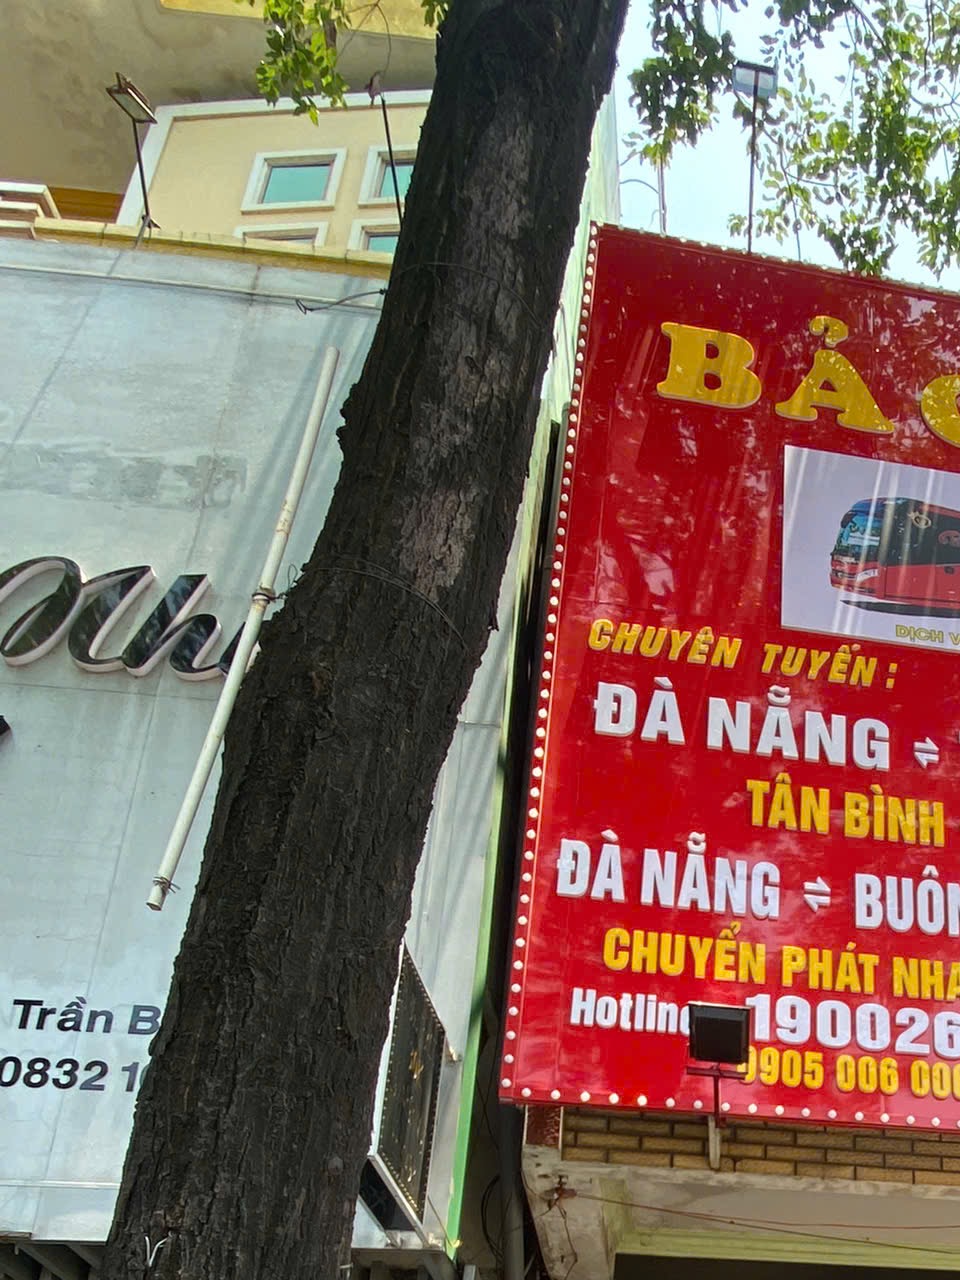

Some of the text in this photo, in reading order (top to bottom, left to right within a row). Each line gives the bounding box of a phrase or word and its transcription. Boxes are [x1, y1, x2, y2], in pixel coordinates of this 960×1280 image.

[588, 618, 742, 669] CHUYÊN
[895, 624, 944, 643] DỊCH
[593, 676, 686, 745] ĐÀ
[707, 684, 890, 771] NẴNG
[746, 772, 830, 834] TÂN
[843, 784, 945, 847] BÌNH
[556, 828, 626, 903] ĐÀ
[640, 831, 780, 920] NẴNG
[603, 921, 767, 986] CHUYỂN
[780, 941, 880, 996] PHÁT
[13, 996, 114, 1034] Trần
[0, 1056, 109, 1092] 0832
[835, 1055, 899, 1097] 006
